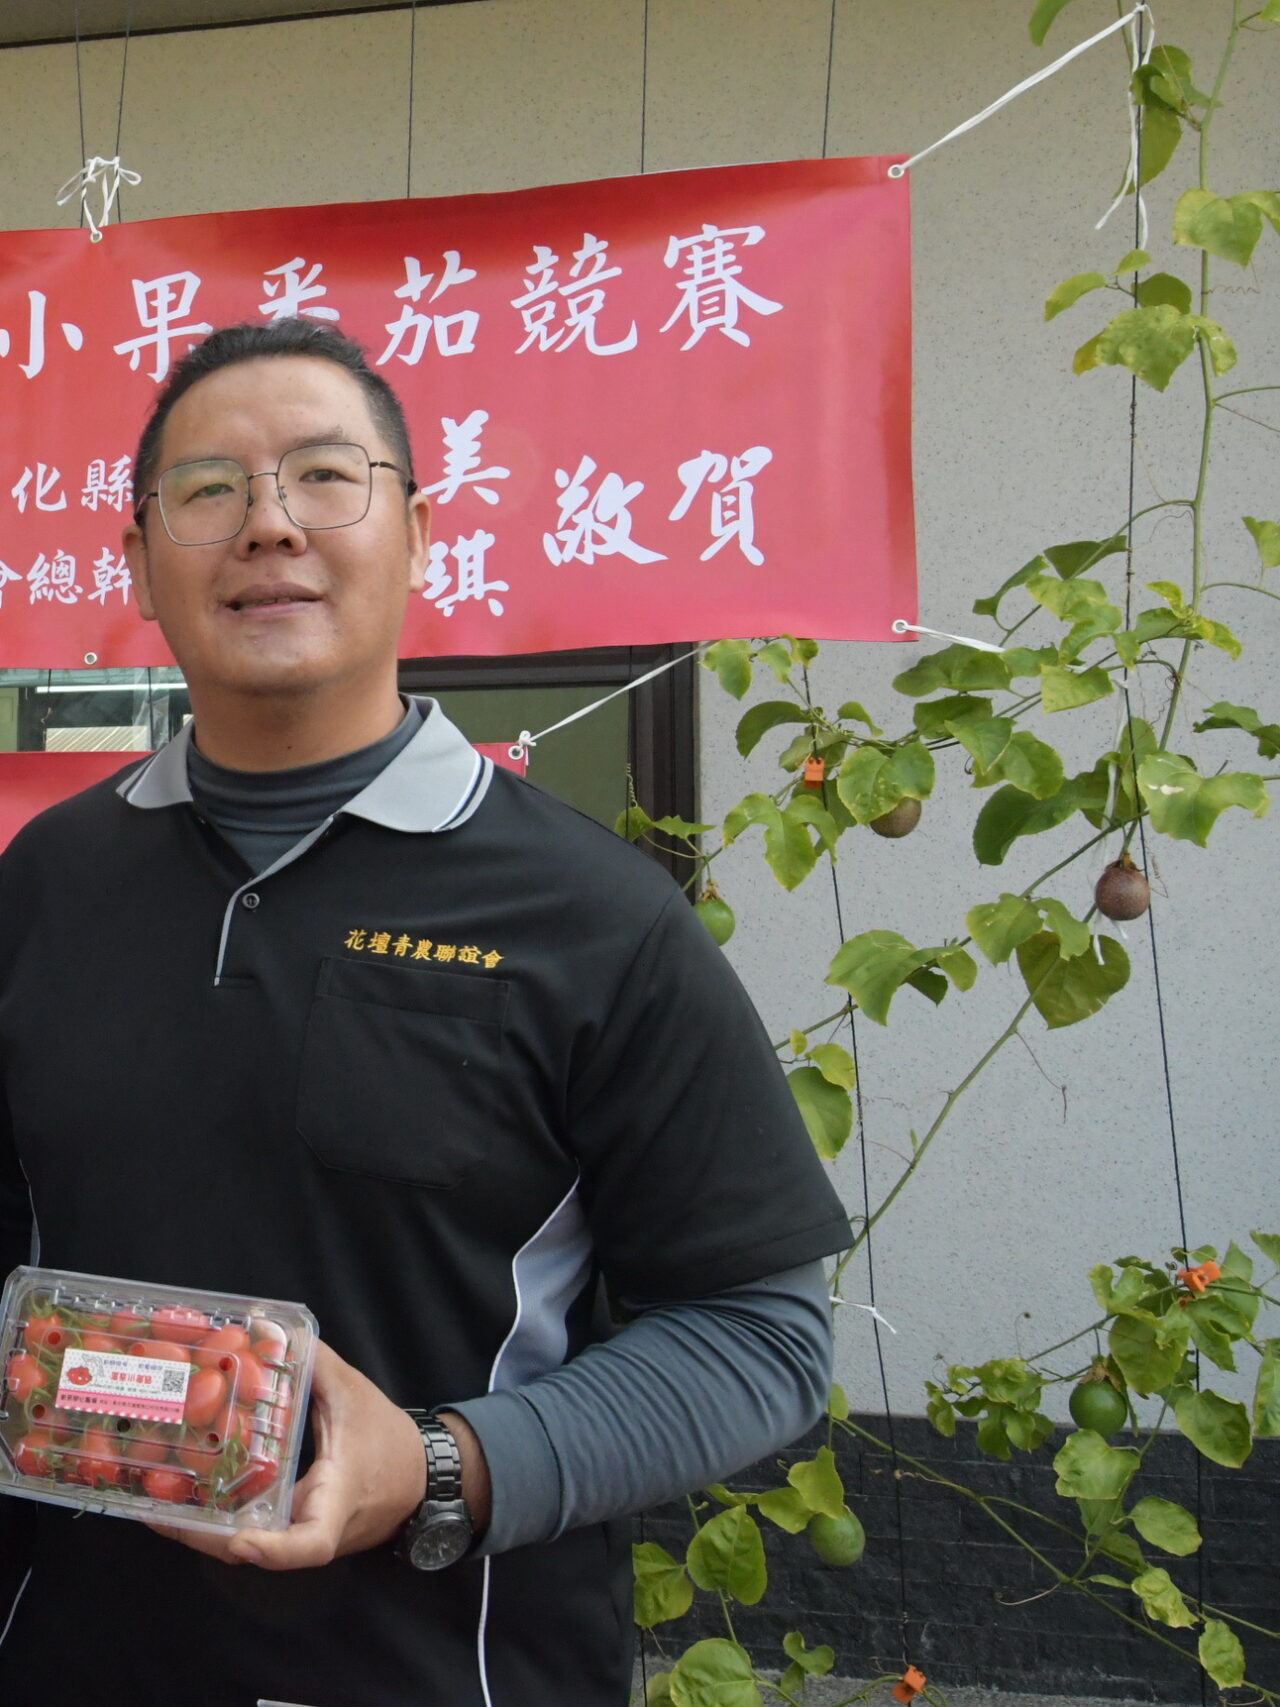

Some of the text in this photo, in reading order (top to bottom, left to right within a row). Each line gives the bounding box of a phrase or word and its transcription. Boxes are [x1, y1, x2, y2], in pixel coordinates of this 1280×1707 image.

[421, 409, 510, 505] 美
[542, 445, 773, 567] 敬賀
[422, 529, 510, 617] 琪
[344, 929, 504, 969] 花壇青農聯誼會
